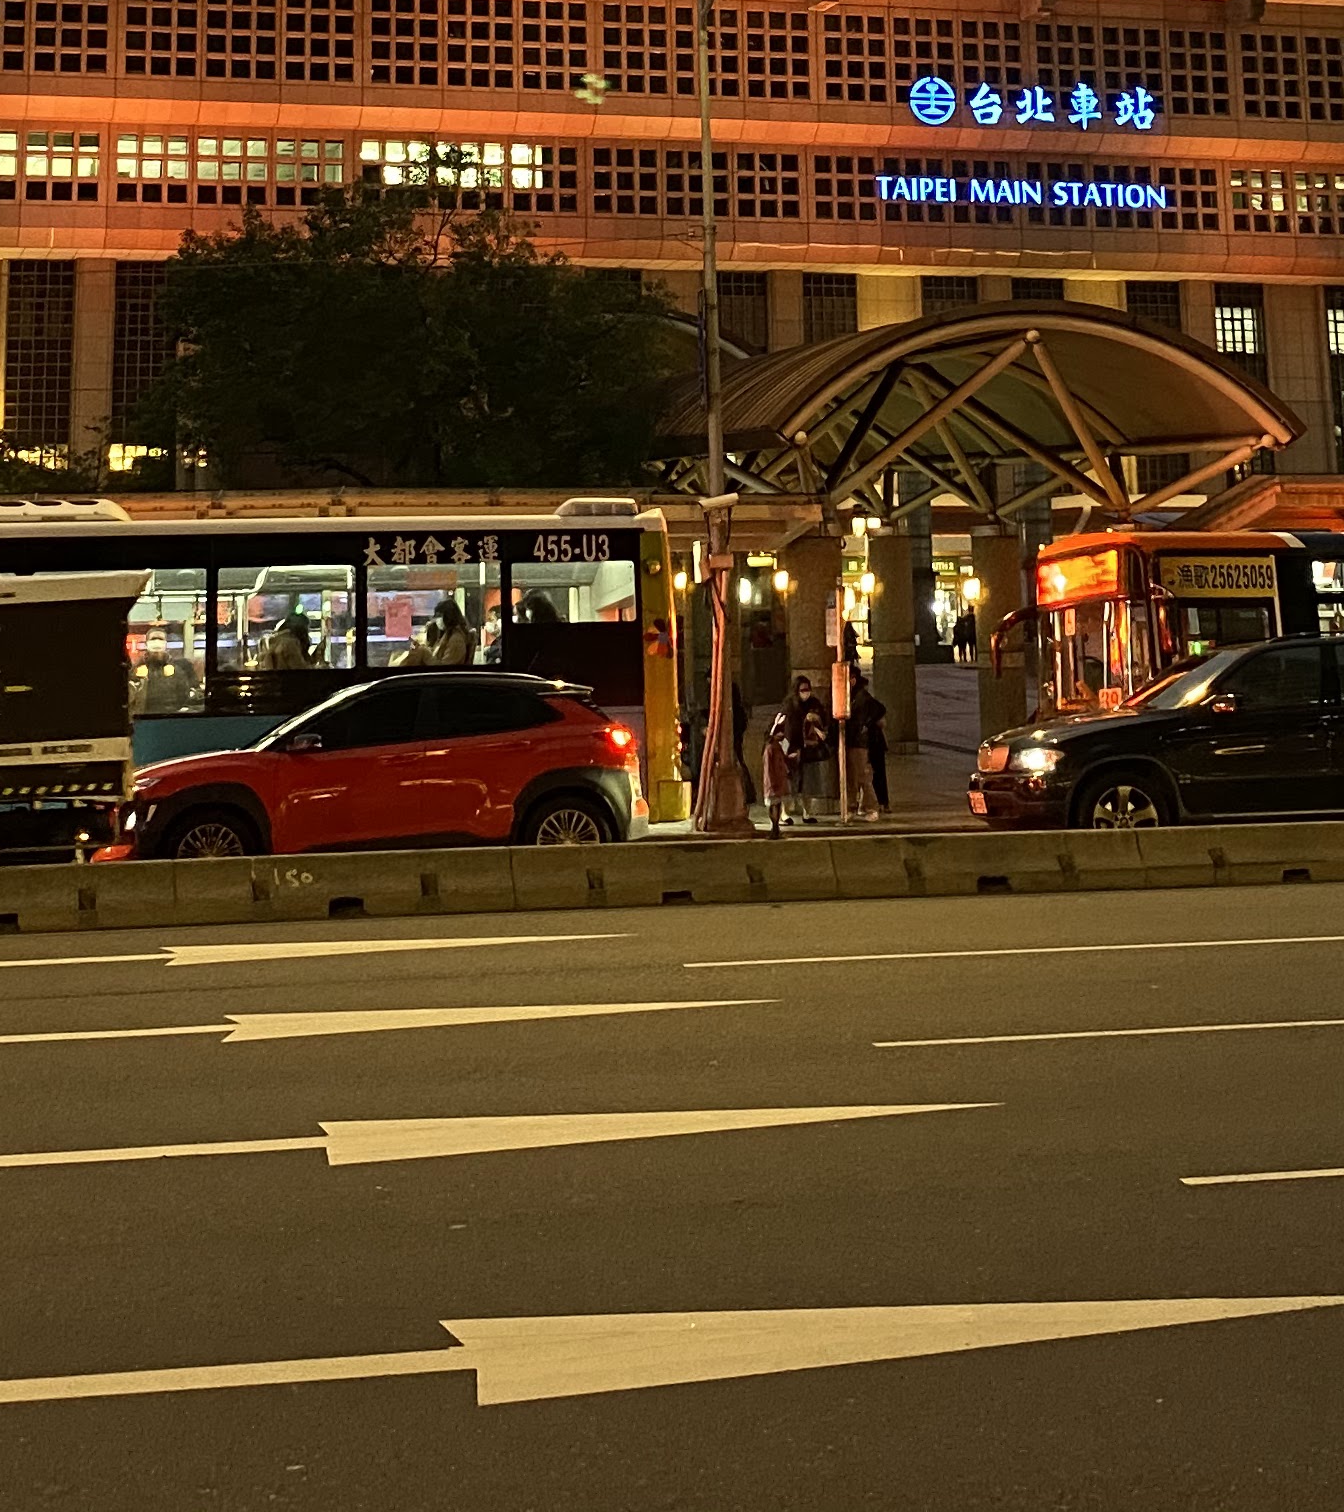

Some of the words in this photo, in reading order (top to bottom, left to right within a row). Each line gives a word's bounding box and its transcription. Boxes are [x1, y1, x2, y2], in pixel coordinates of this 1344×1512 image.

[969, 82, 1154, 130] 台北車站
[875, 175, 956, 202] TAIPEI
[970, 178, 1042, 205] MAIN
[1053, 181, 1166, 209] STATION
[363, 535, 502, 566] 大都會客運
[533, 534, 610, 562] 455-U3
